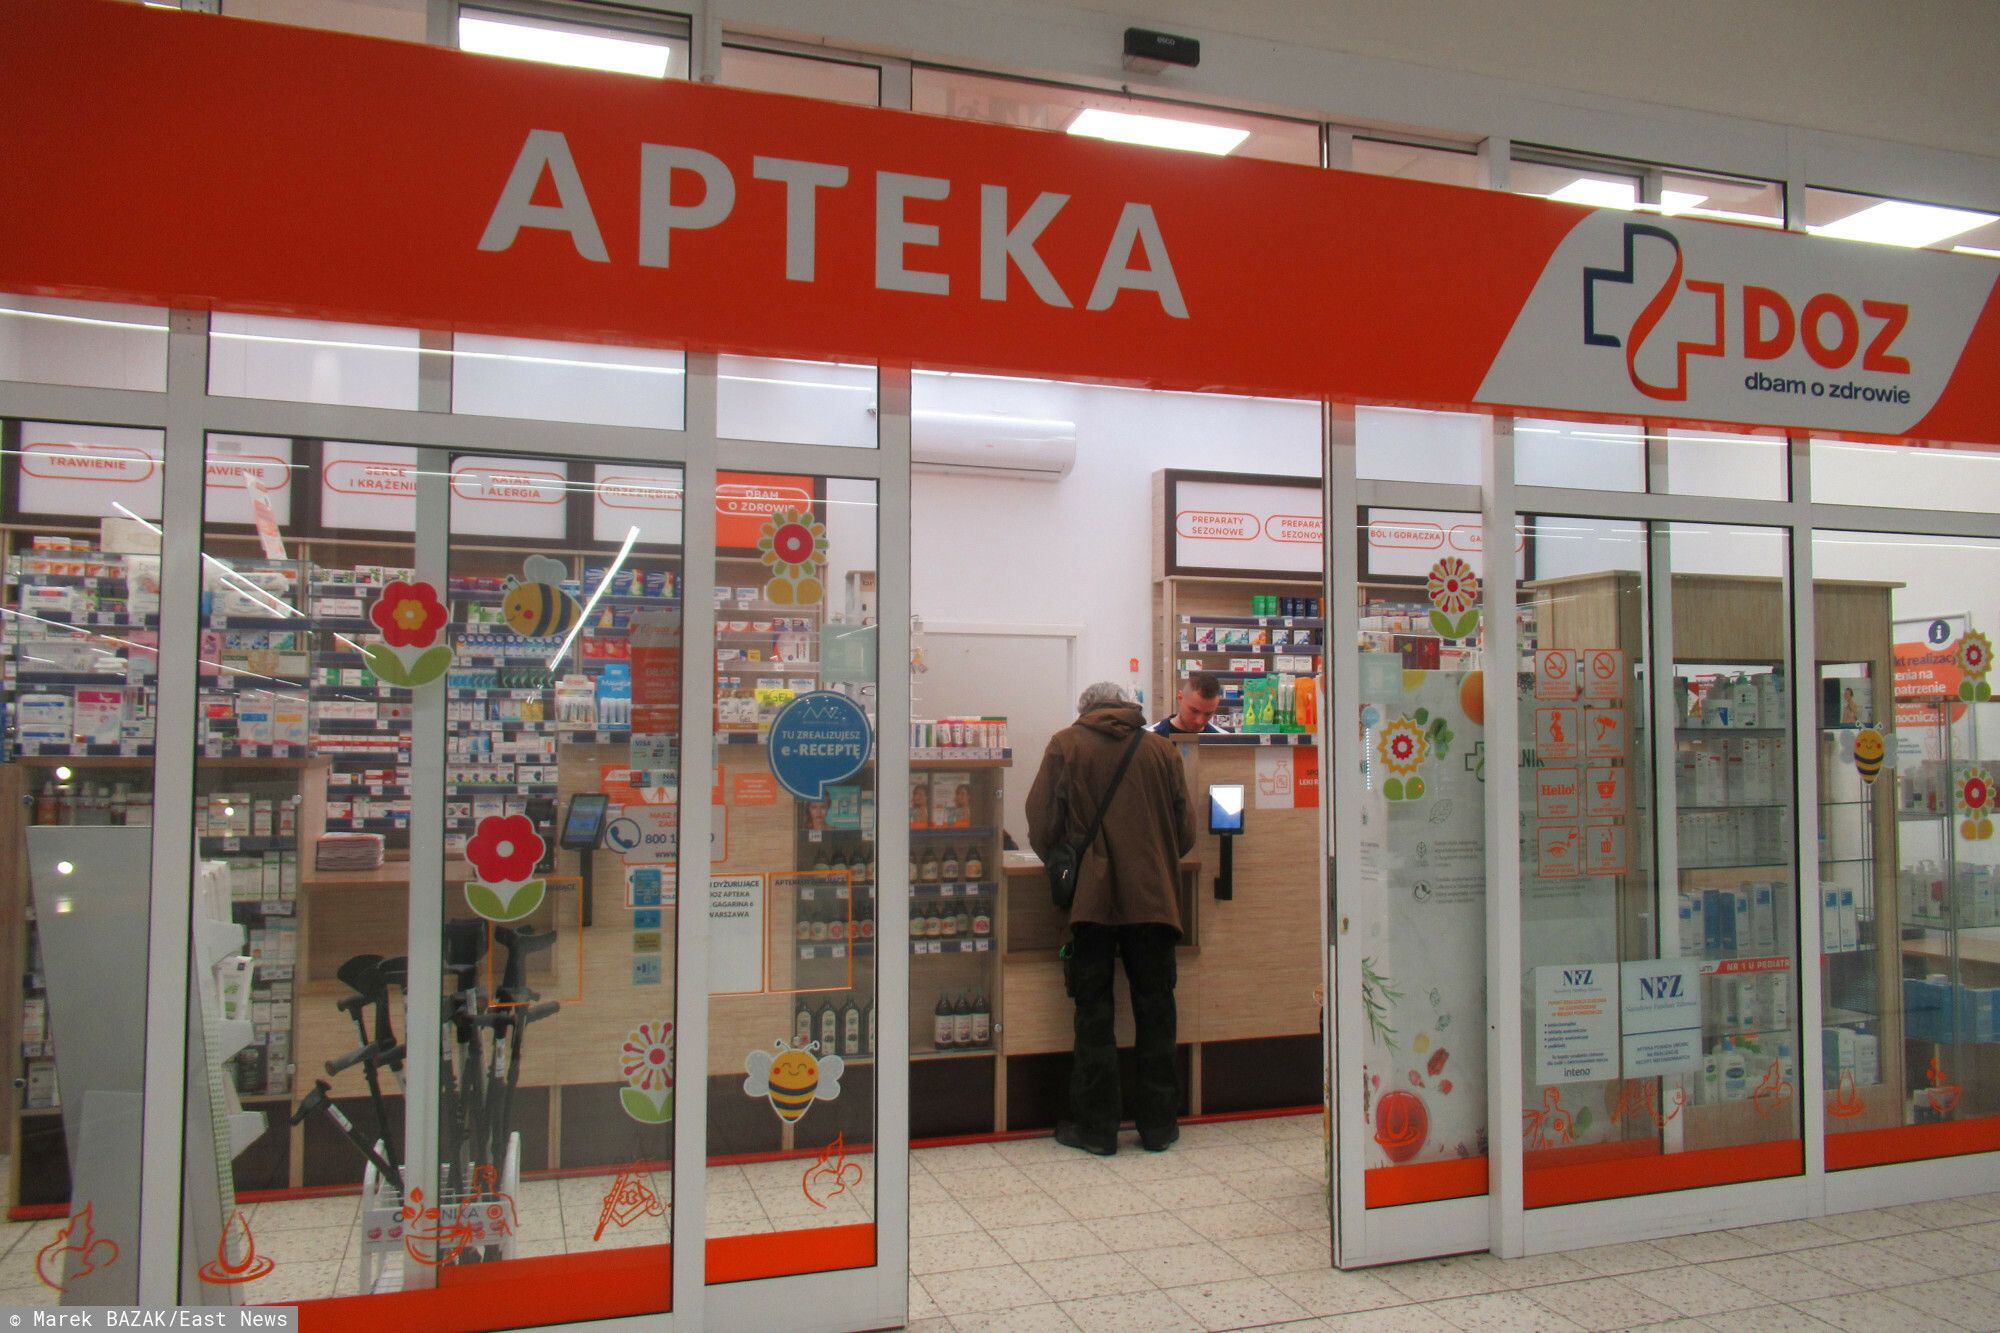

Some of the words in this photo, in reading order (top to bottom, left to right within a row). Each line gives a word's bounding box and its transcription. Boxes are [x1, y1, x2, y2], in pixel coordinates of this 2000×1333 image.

[476, 128, 1190, 320] APTEKA
[1743, 286, 1910, 374] DOZ
[1745, 372, 1806, 395] dbam
[1811, 382, 1824, 397] o
[1829, 381, 1911, 404] zdrowie
[49, 455, 127, 470] TRAWIENIE
[207, 466, 265, 478] AWIENIE
[488, 487, 541, 498] ALERGIA
[745, 489, 779, 499] DBAM
[728, 502, 738, 511] O
[1192, 515, 1244, 526] PREPARATY
[1281, 520, 1323, 529] PREPARAT
[1192, 527, 1244, 536] SEZONOWE
[1281, 530, 1323, 540] SEZONOW
[1394, 531, 1441, 542] GORĄCZKA
[1920, 669, 1934, 680] na
[782, 730, 796, 739] TU
[797, 730, 861, 740] ZREALIZUJESZ
[1542, 783, 1576, 797] Hello!
[645, 834, 666, 844] 800
[1563, 969, 1594, 986] NFZ
[1639, 974, 1684, 1001] NFZ
[1564, 1067, 1591, 1078] inteno
